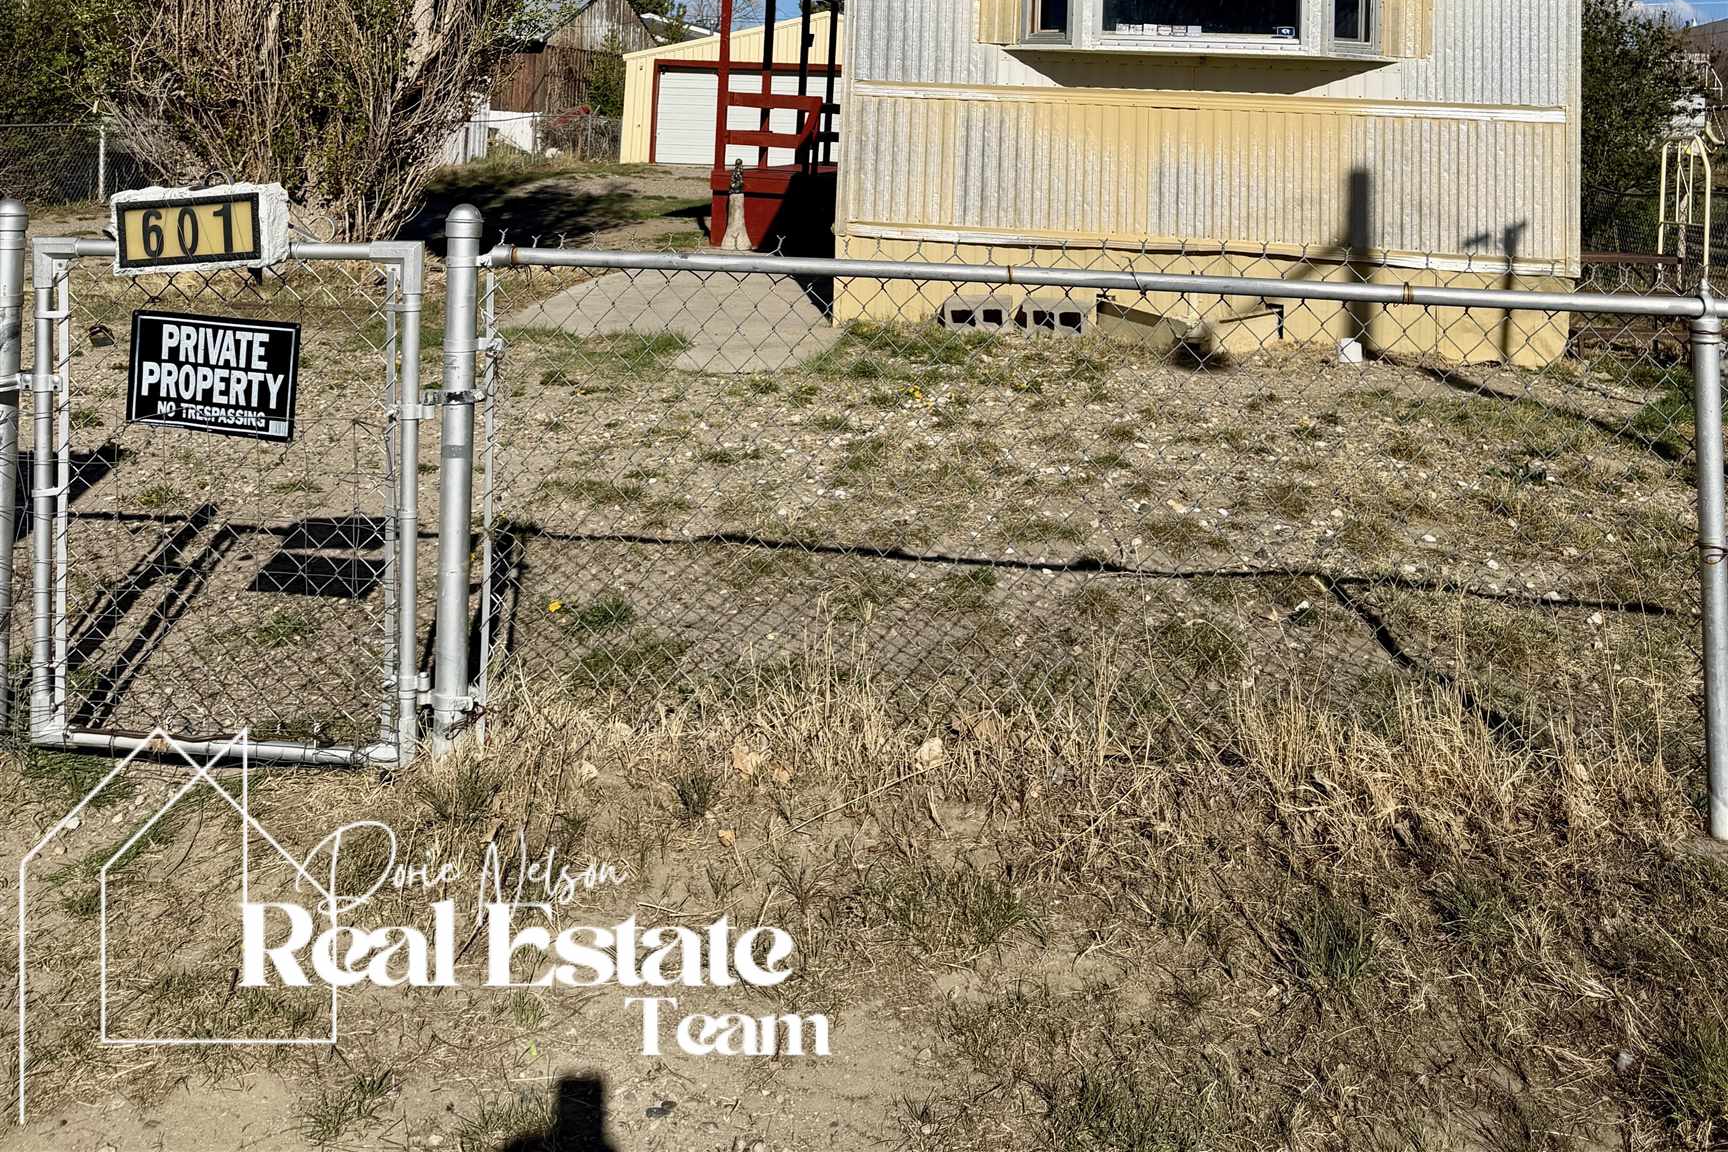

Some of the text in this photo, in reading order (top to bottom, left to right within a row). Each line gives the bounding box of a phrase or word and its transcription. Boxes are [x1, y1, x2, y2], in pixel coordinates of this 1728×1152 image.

[141, 202, 234, 257] 601
[161, 323, 270, 371] PRIVATE
[140, 361, 286, 409] PROPERTY
[156, 400, 266, 427] NO TRESPASSING
